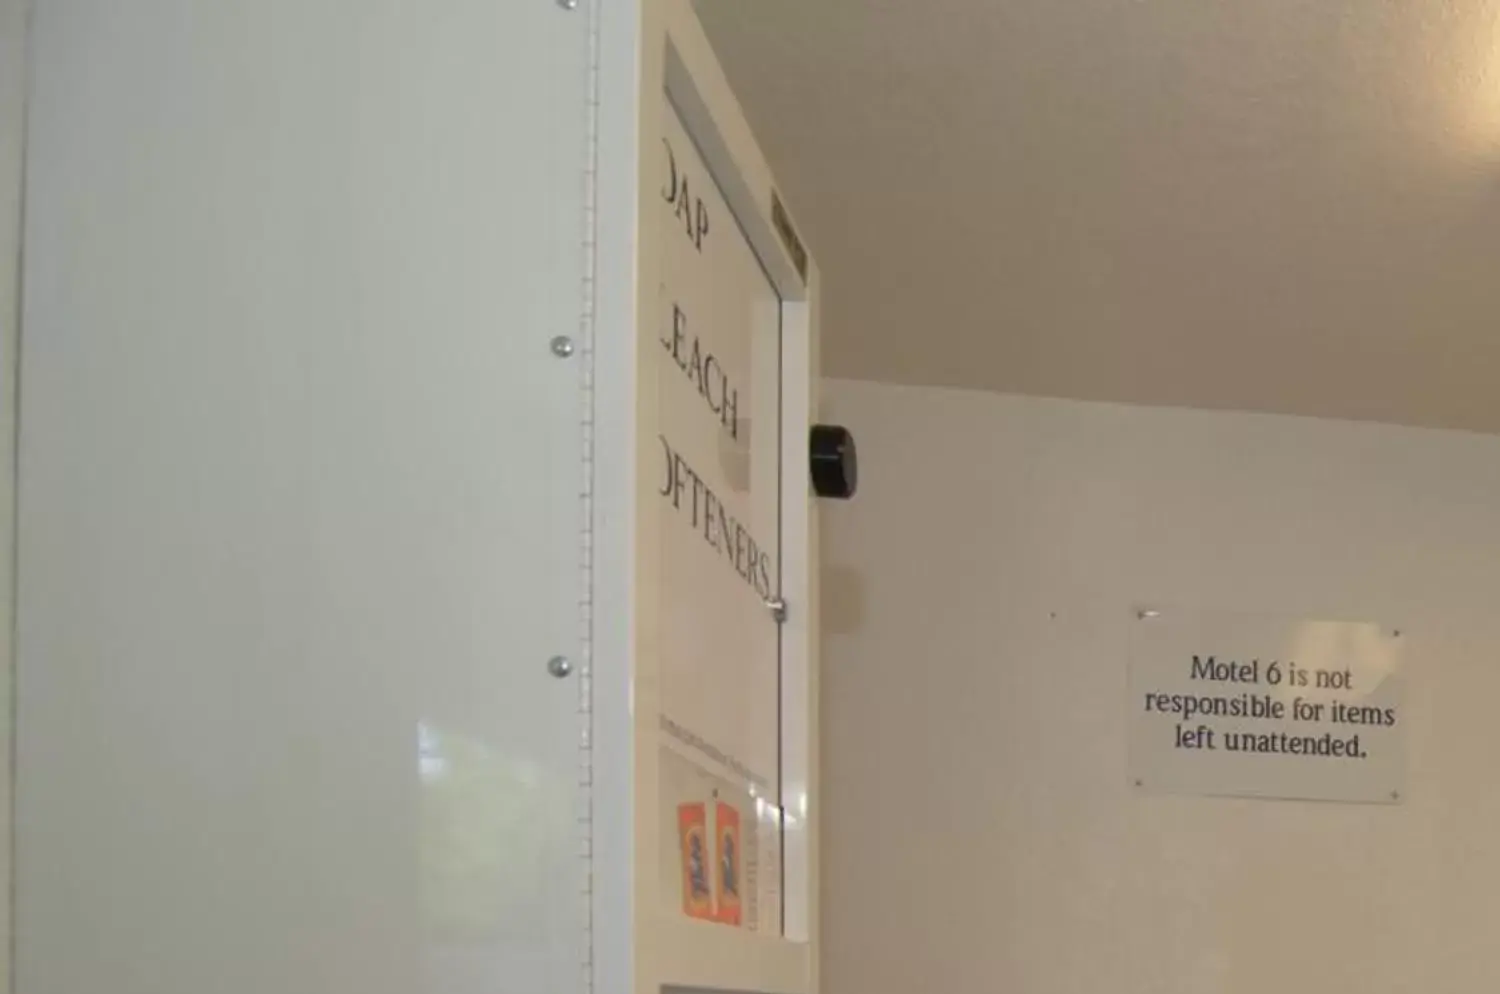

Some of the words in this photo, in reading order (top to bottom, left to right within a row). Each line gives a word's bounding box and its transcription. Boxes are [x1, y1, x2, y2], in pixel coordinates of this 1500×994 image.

[1190, 655, 1258, 684] Motel
[1265, 662, 1282, 686] 6
[1288, 662, 1308, 688] is
[1315, 666, 1352, 691] not
[1144, 692, 1285, 720] responsible
[1292, 696, 1325, 721] for
[1331, 700, 1396, 726] items
[1174, 724, 1216, 750] left
[1224, 730, 1367, 759] unattended.
